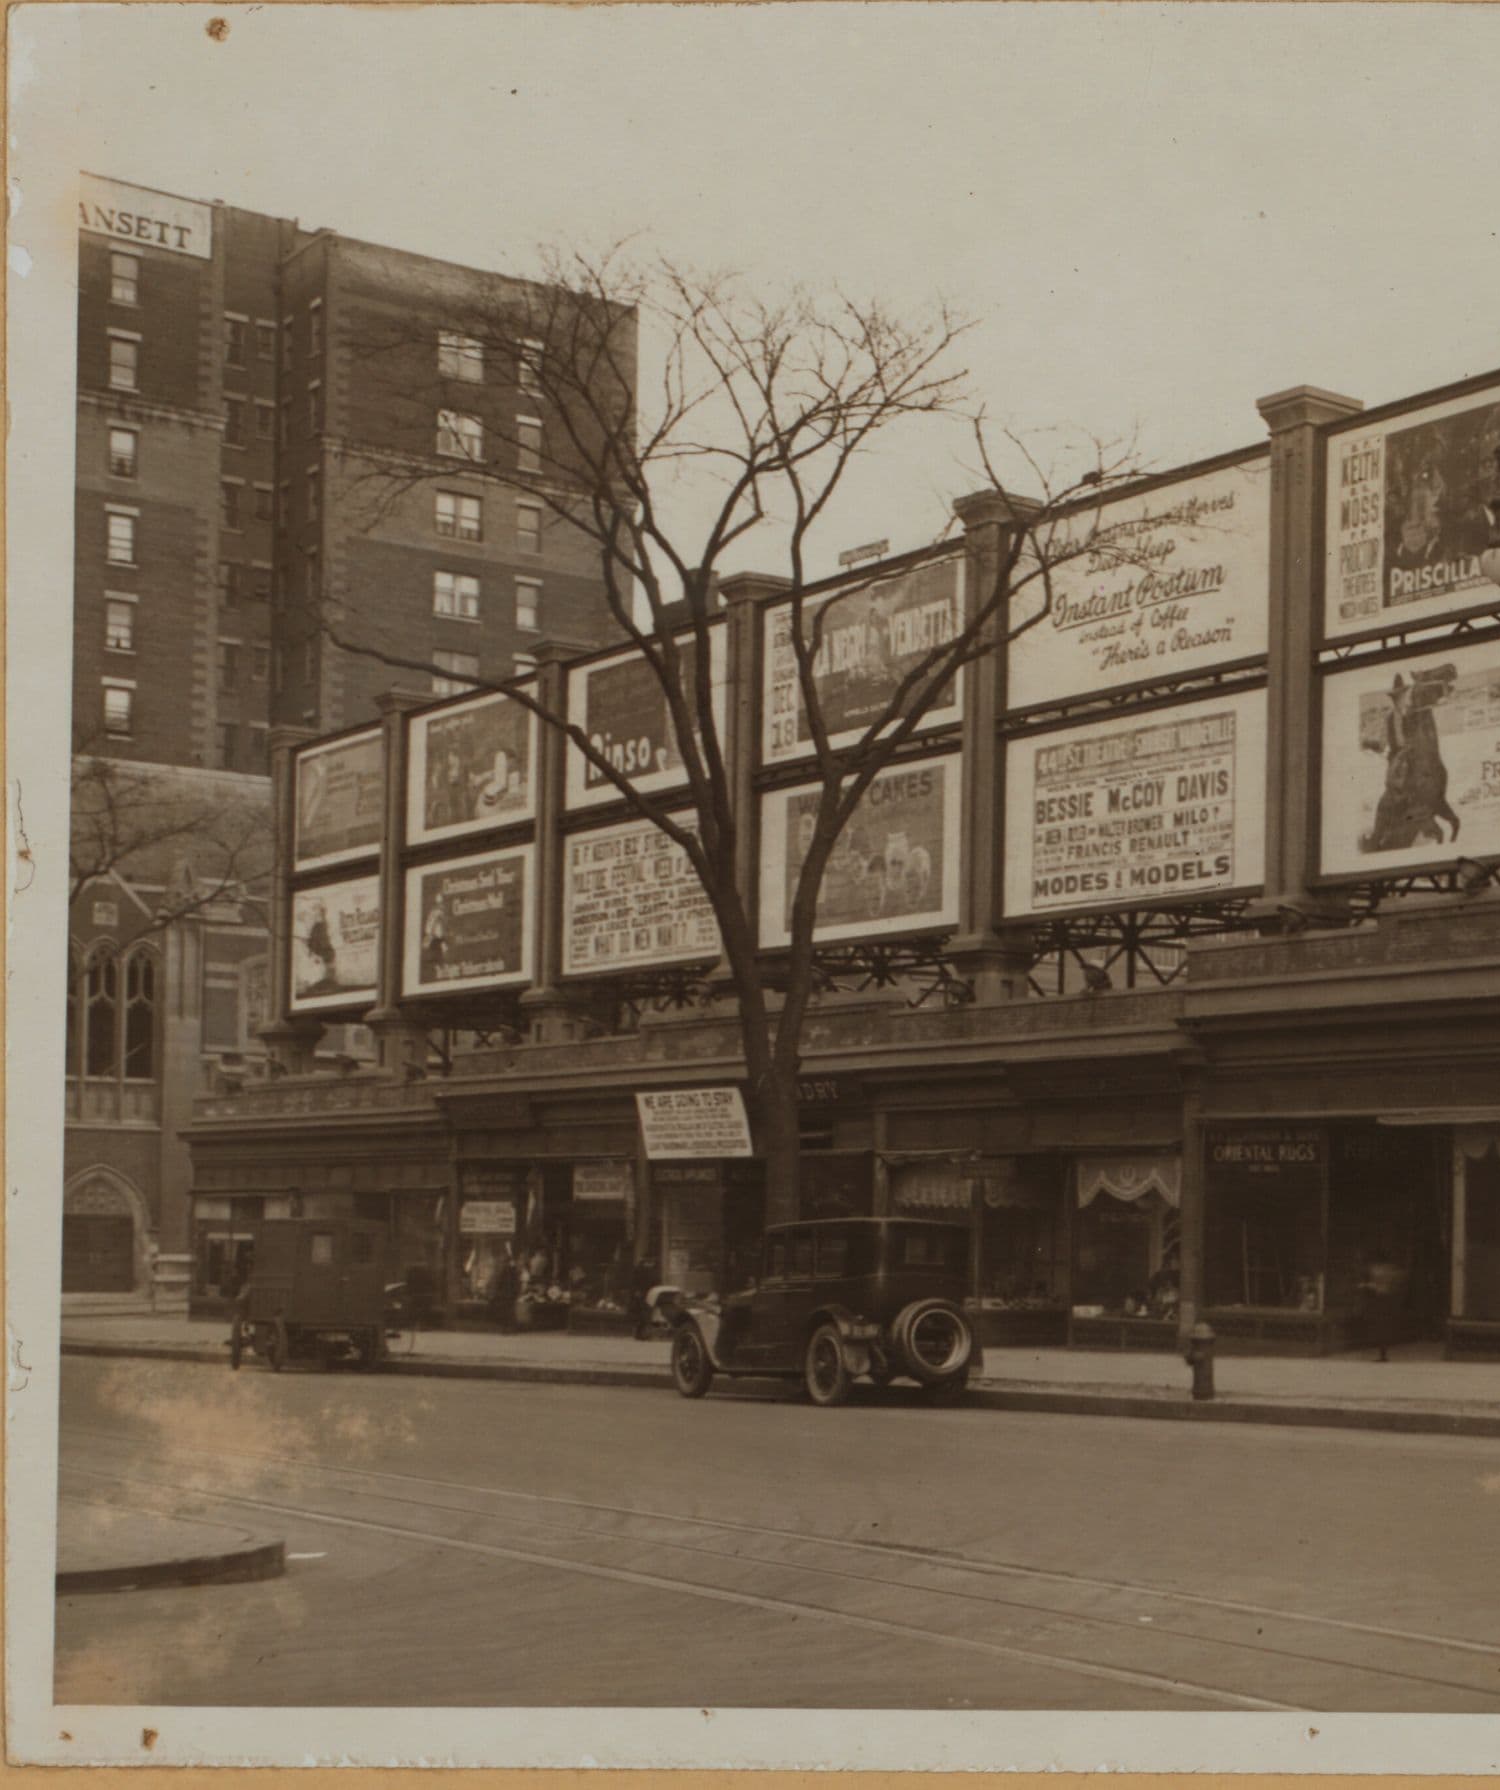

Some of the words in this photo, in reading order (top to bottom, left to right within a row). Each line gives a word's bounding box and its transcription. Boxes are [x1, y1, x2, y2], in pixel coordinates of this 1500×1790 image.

[1341, 447, 1380, 488] KEITH
[1341, 493, 1379, 531] MOSS
[1052, 580, 1134, 628] Instant
[1136, 565, 1225, 605] Postum
[1389, 556, 1481, 598] PRISCILLA
[1078, 621, 1126, 645] instead
[1130, 615, 1144, 637] of
[1150, 604, 1190, 632] Coffee
[1156, 641, 1166, 655] a
[771, 716, 795, 751] 18
[588, 732, 652, 784] Rinso
[869, 771, 933, 807] CAKES
[1035, 791, 1094, 826] BESSIE
[1107, 780, 1166, 814] McCOY
[1176, 770, 1229, 804] DAVIS
[1066, 840, 1122, 860] FRANCIS
[1128, 831, 1190, 854] RENAULT
[1032, 872, 1109, 898] MODES
[1129, 855, 1230, 887] MODELS
[1213, 1144, 1274, 1163] ORIENTAL
[1278, 1143, 1316, 1162] RUGS
